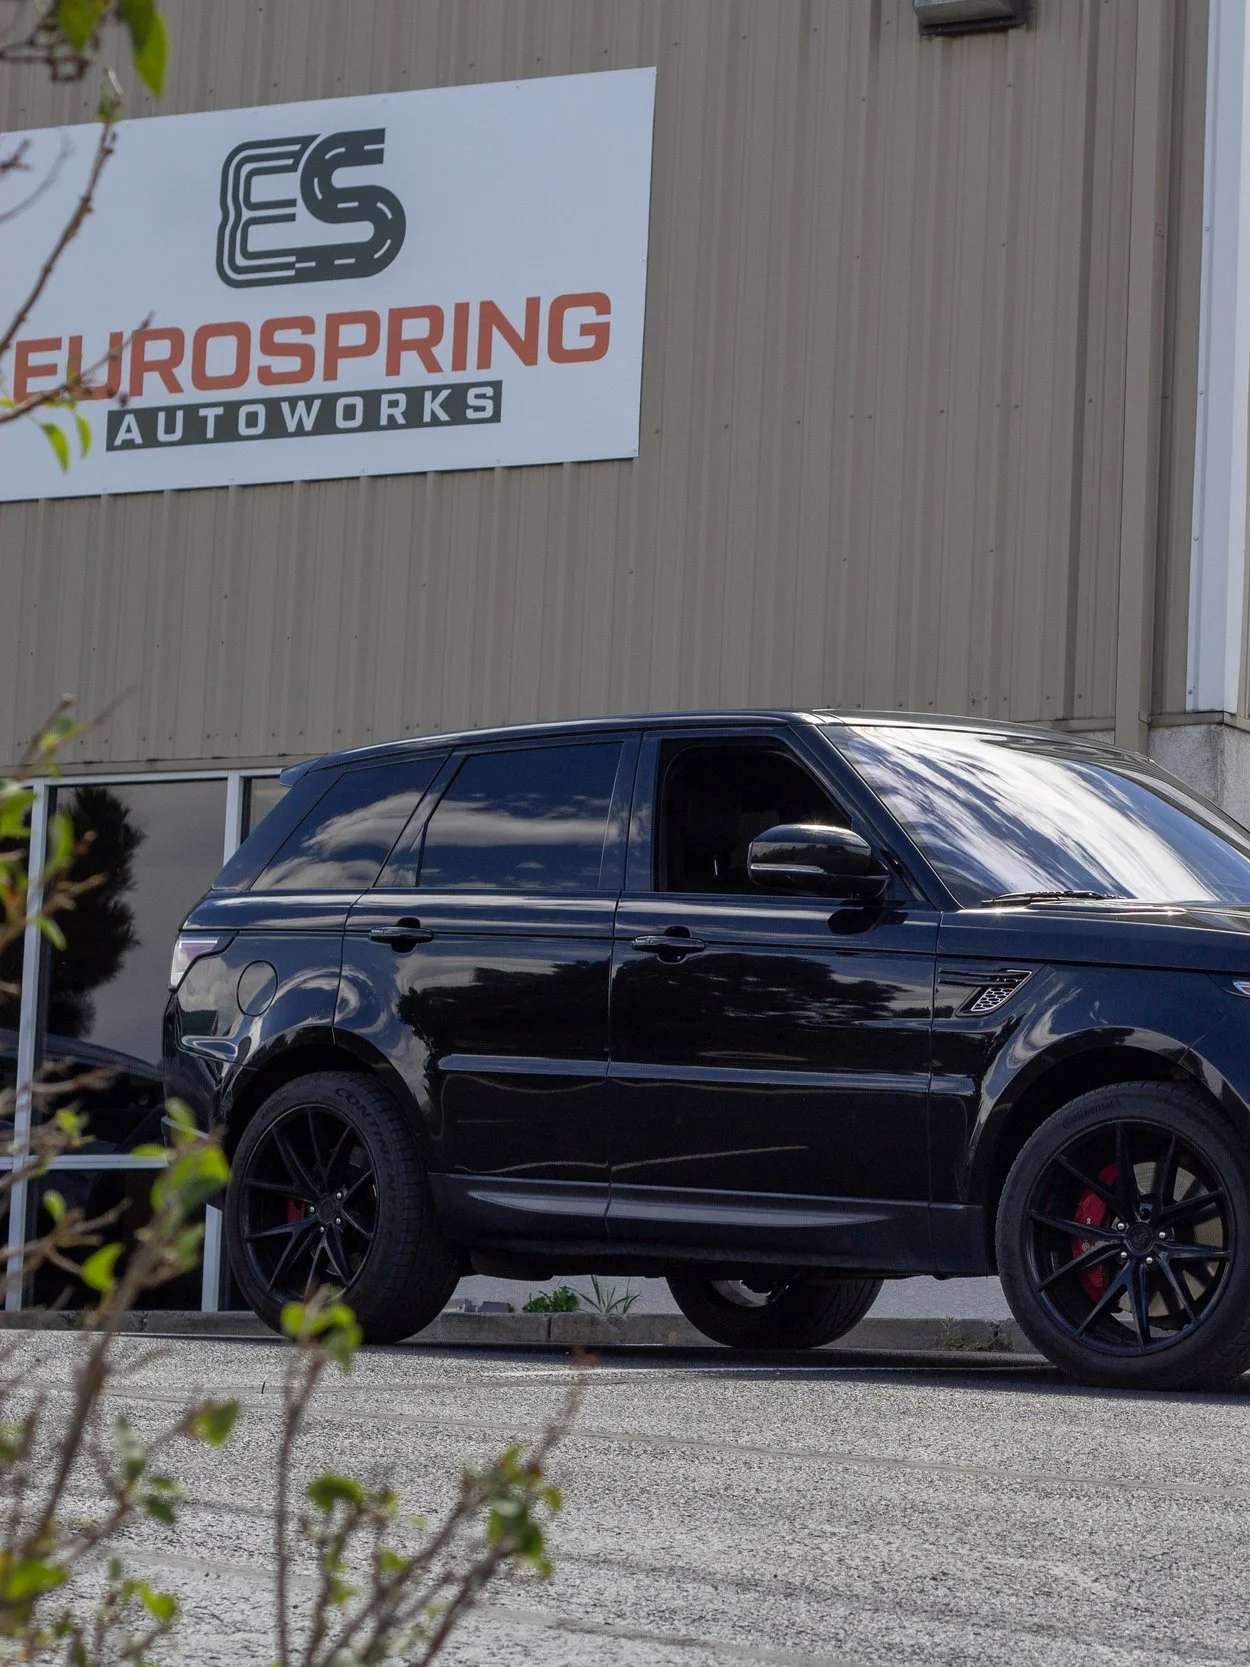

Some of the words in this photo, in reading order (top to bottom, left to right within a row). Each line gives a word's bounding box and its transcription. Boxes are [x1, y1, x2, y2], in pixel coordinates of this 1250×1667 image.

[216, 128, 406, 288] ES
[13, 291, 611, 403] EUROSPRING
[113, 386, 495, 447] AUTOWORKS
